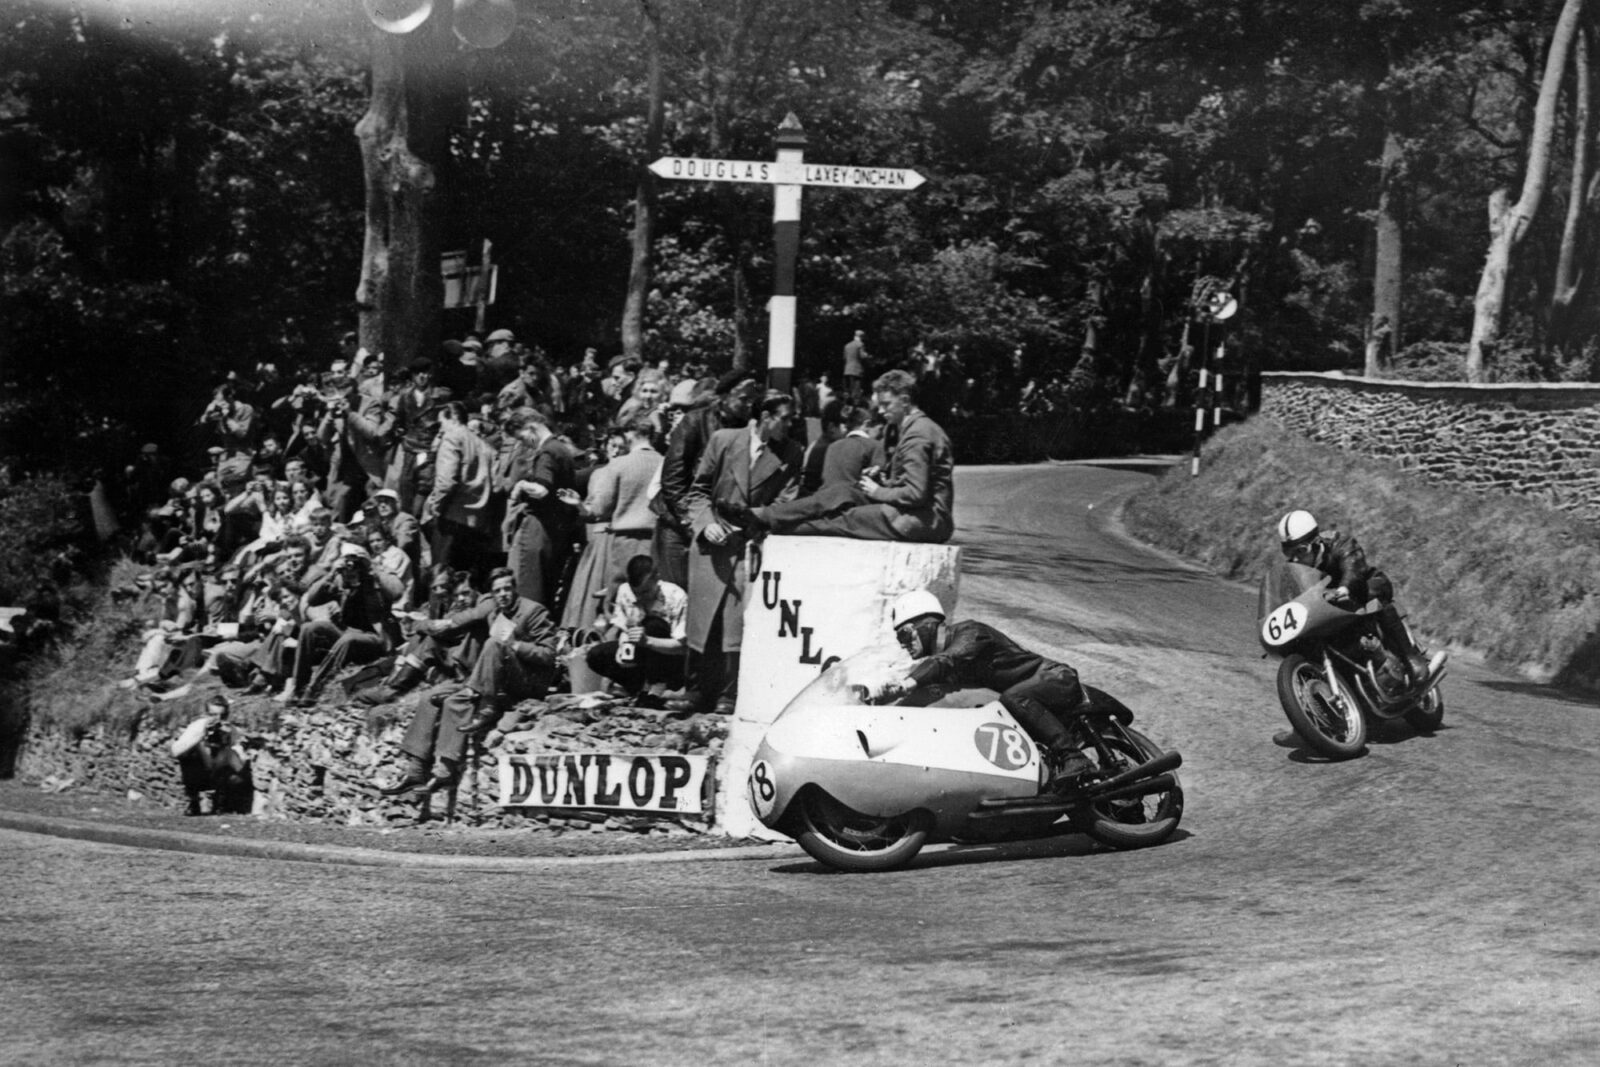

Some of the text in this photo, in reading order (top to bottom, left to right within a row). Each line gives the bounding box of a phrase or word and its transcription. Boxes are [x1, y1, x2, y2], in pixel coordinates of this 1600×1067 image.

[673, 159, 768, 180] DOUGLAS
[749, 543, 842, 674] DUNL
[1268, 607, 1298, 641] 64
[979, 726, 1028, 765] 78
[509, 755, 691, 809] DUNLOP
